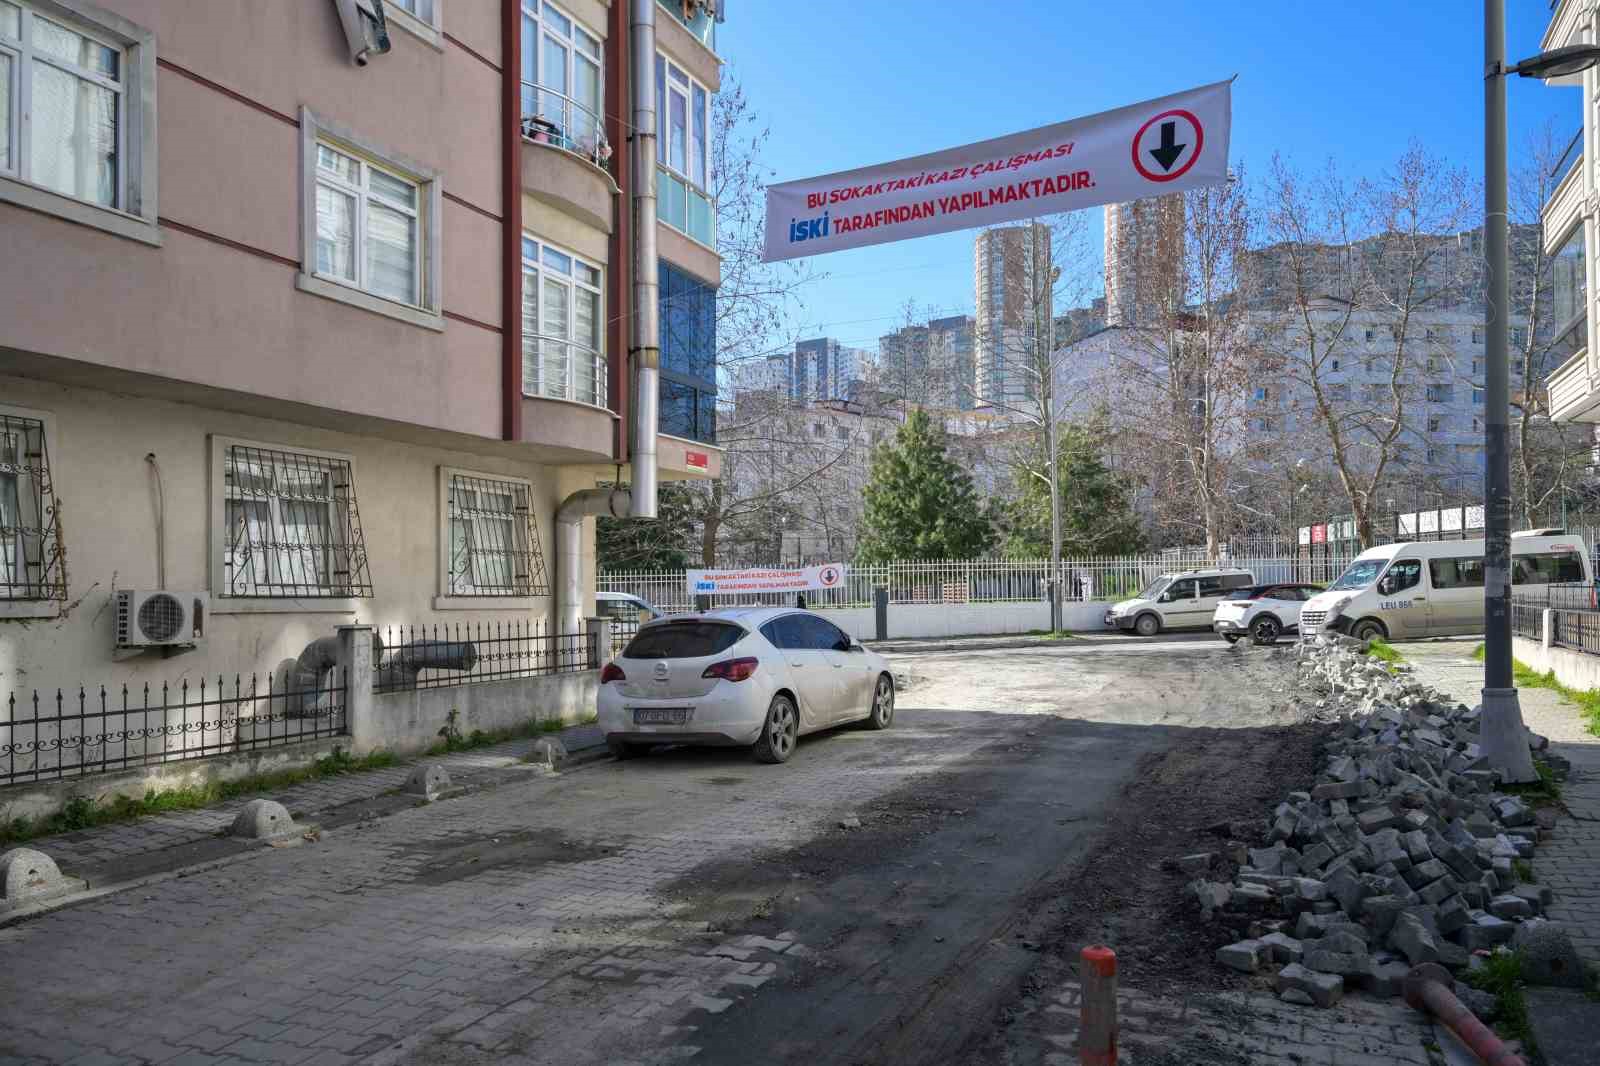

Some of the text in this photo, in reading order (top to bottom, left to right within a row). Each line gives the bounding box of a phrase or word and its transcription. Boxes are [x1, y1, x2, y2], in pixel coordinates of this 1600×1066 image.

[789, 170, 1097, 243] İSKİ TARAFINDAN YAPILMAKTADIR.
[807, 141, 1075, 209] BU SOKAKTAKİ KAZI ÇALIŞMASI
